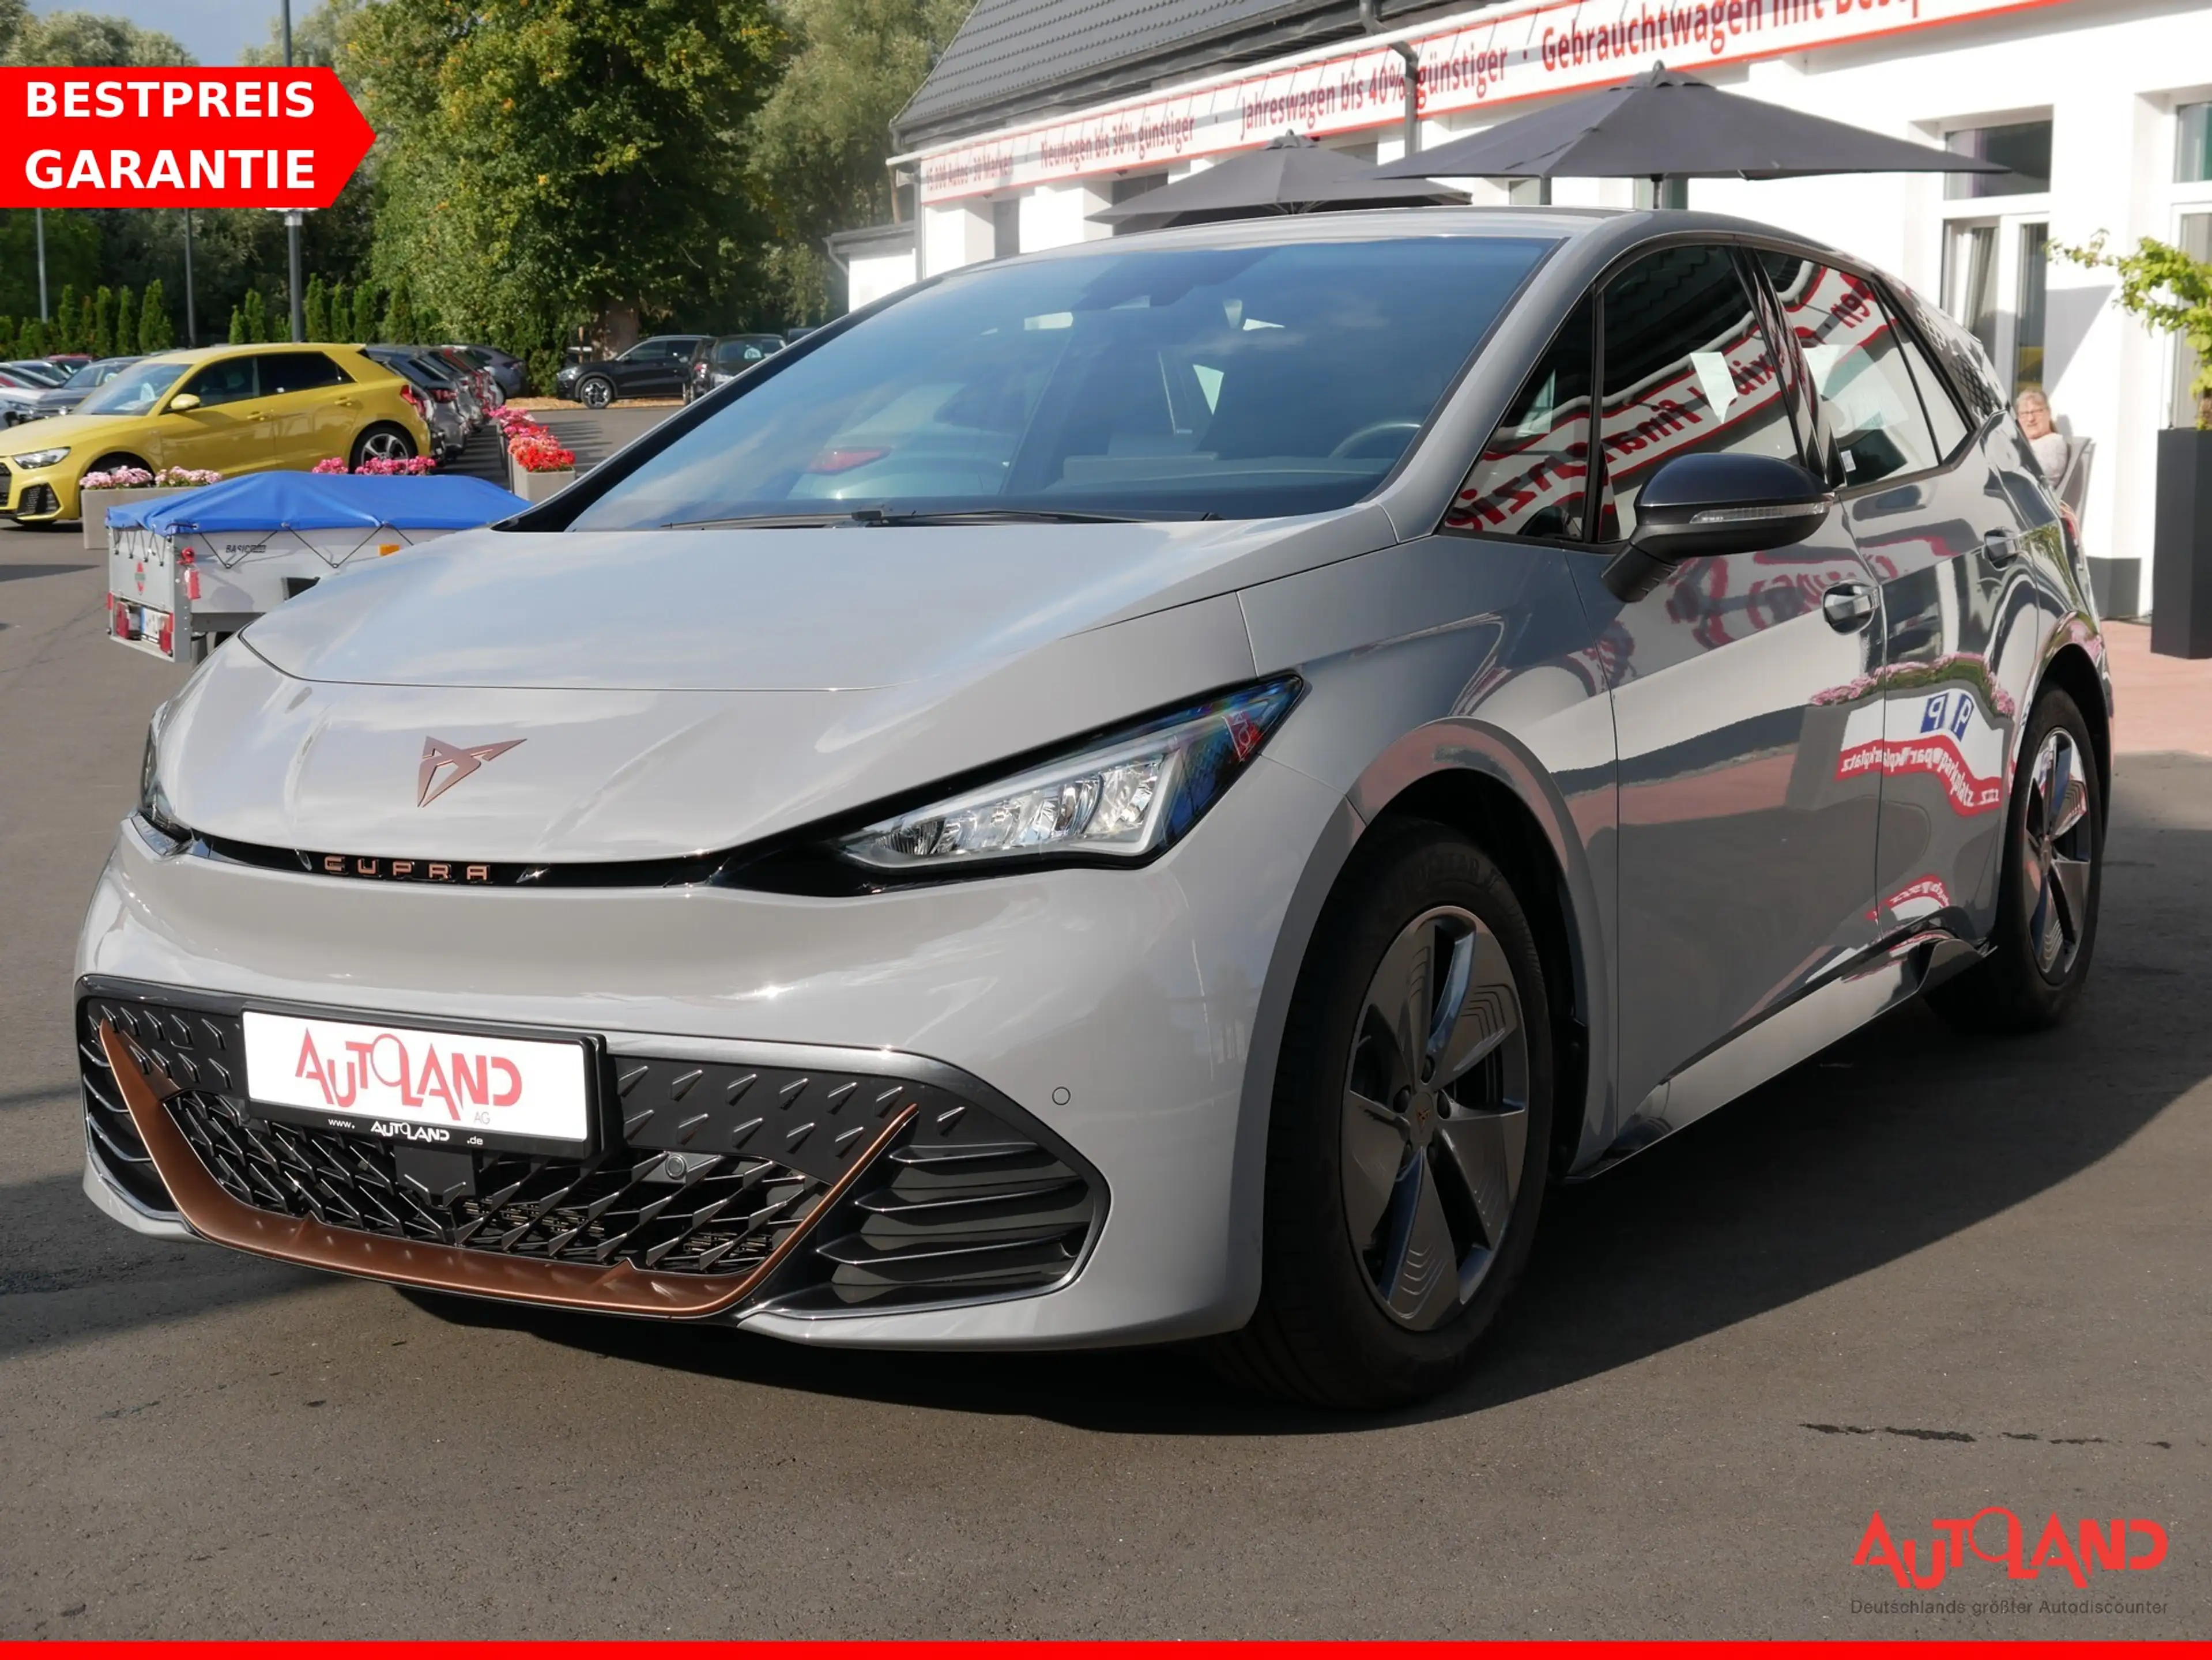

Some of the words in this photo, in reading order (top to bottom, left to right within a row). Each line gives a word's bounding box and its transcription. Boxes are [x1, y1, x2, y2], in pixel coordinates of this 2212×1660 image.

[1041, 139, 1092, 171] Neuwagen
[1095, 126, 1110, 159] bis
[1112, 121, 1136, 155] 30%
[1138, 111, 1195, 160] günstiger
[1240, 86, 1336, 141] Jahreswagen
[1341, 71, 1363, 111] bis
[1369, 62, 1406, 106] 40%
[1416, 43, 1508, 110] günstiger
[1542, 0, 1762, 72] Gebrauchtwagen
[324, 855, 491, 881] CUPRA
[295, 1027, 523, 1122] AUTOLAND
[328, 1118, 355, 1130] www.
[371, 1120, 450, 1143] AUTOLAND
[467, 1135, 484, 1145] .de
[473, 1111, 491, 1126] AG
